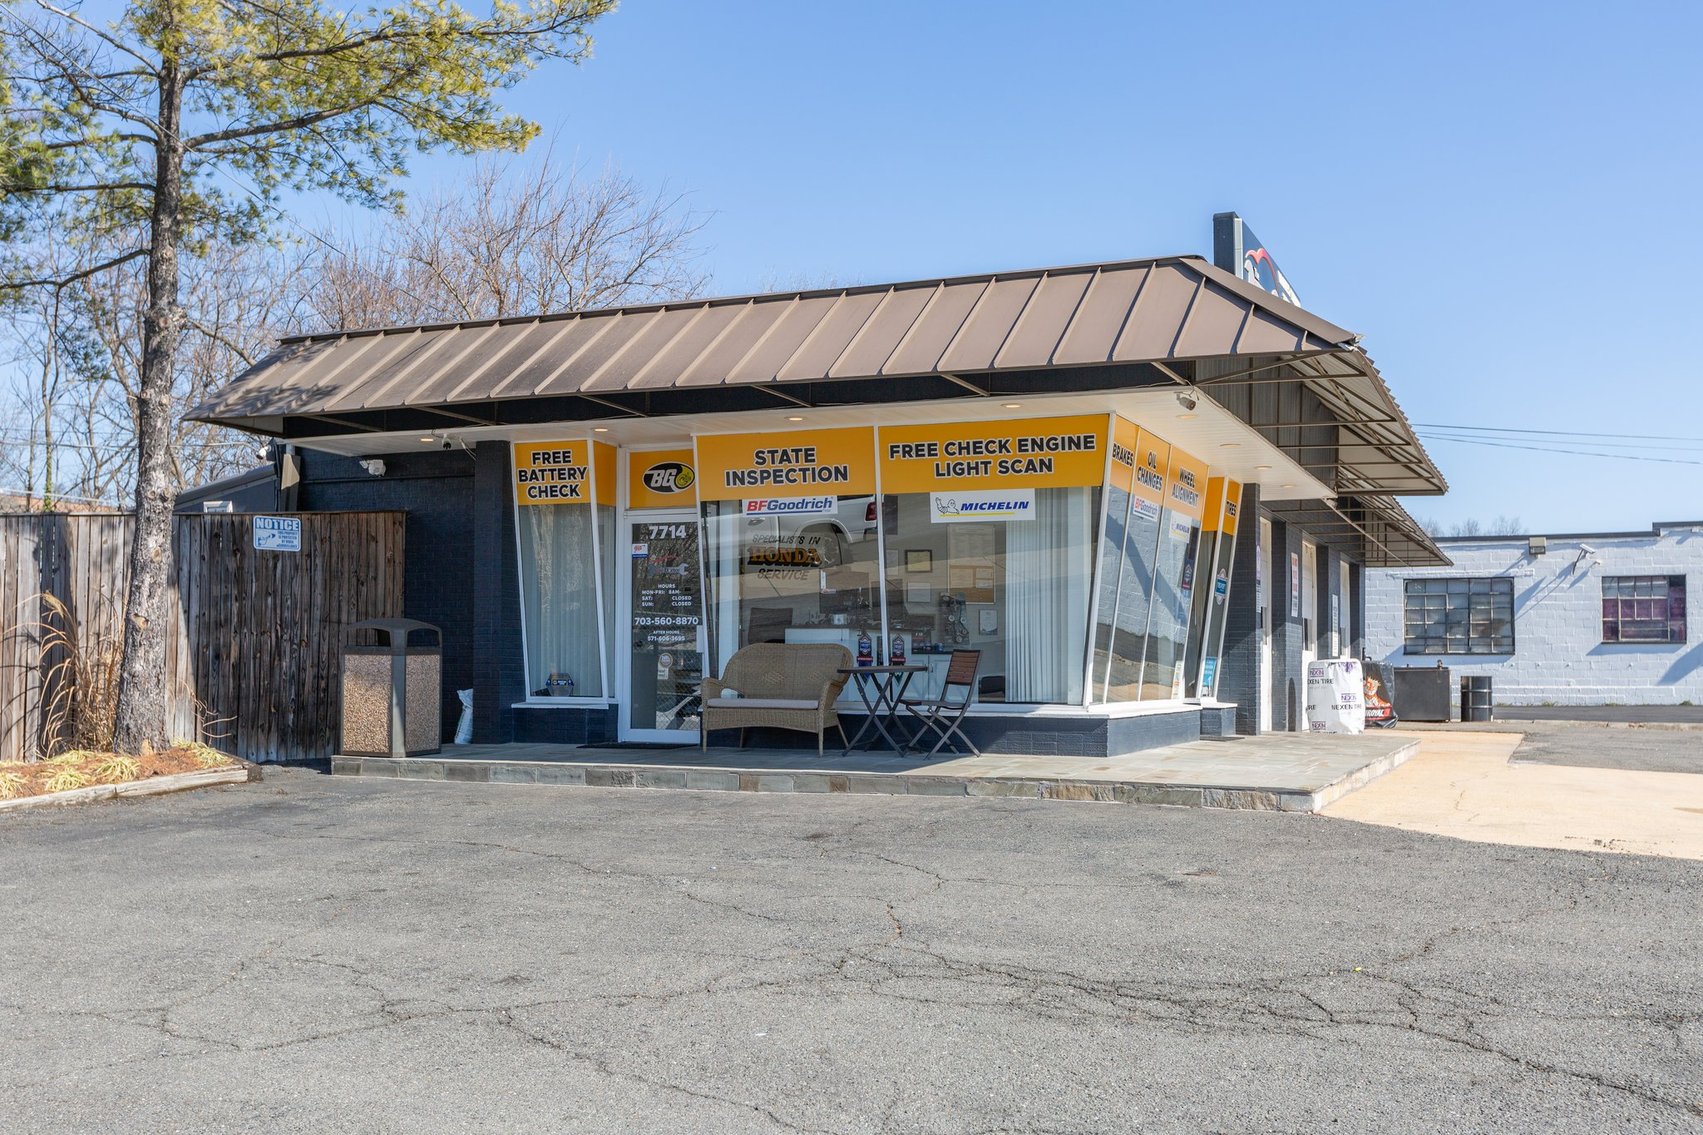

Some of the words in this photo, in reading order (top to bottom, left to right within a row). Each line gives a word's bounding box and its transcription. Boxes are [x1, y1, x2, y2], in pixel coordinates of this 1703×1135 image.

[889, 442, 938, 459] FREE
[944, 439, 1011, 456] CHECK
[1018, 435, 1096, 453] ENGINE
[1112, 443, 1134, 467] BRAKES
[532, 450, 572, 465] FREE
[755, 447, 816, 466] STATE
[1147, 451, 1157, 469] OIL
[518, 467, 588, 483] BATTERY
[935, 460, 992, 477] LIGHT
[998, 457, 1053, 475] SCAN
[649, 469, 677, 487] BG
[725, 465, 849, 487] INSPECTION
[1137, 466, 1162, 491] CHANGES
[1179, 468, 1195, 489] WHEEL
[527, 484, 581, 499] CHECK
[747, 498, 833, 512] BFGoodrich
[960, 501, 1030, 511] MICHELIN
[1226, 500, 1237, 517] TIRES
[256, 518, 299, 530] NOTICE
[649, 525, 687, 539] 7714
[752, 534, 804, 545] SPECIALISTS
[808, 536, 821, 545] IN
[748, 546, 822, 567] HONDA
[757, 568, 810, 581] SERVICE
[634, 617, 699, 625] 703-560-8870
